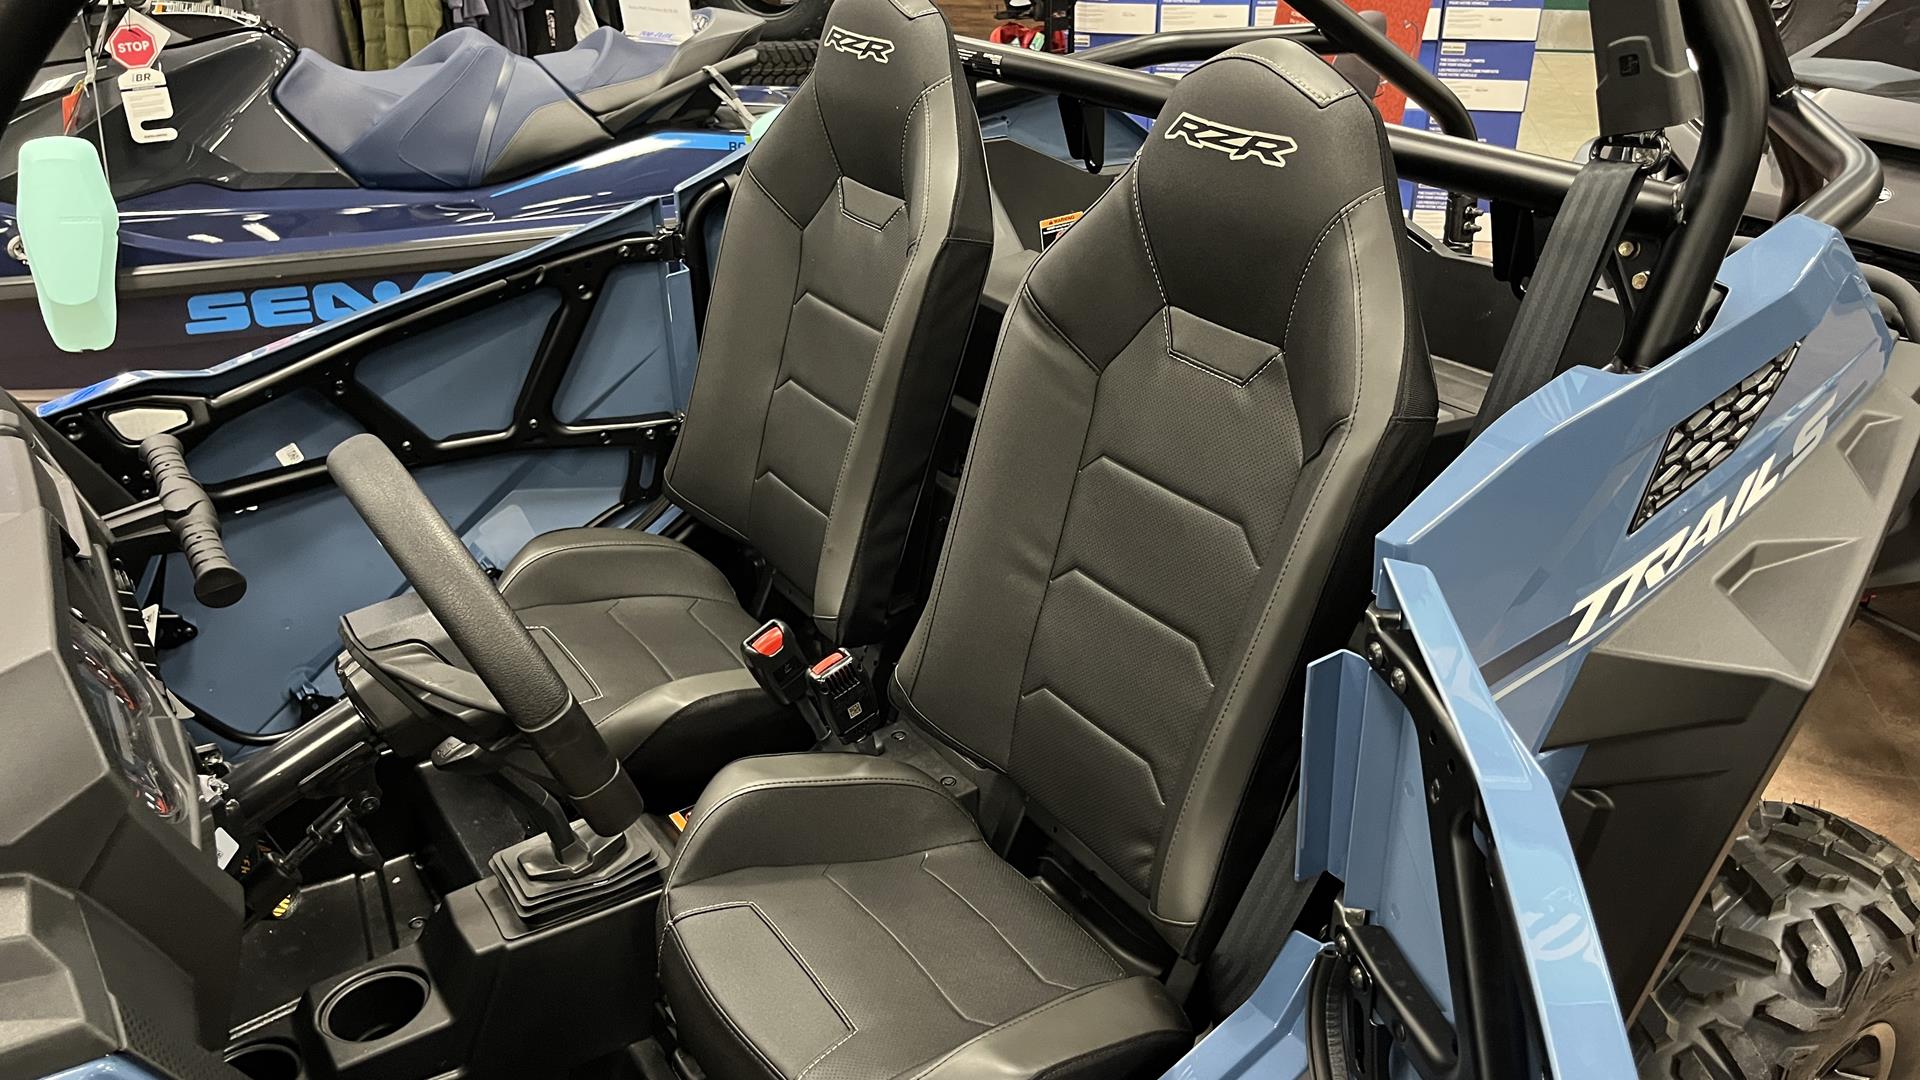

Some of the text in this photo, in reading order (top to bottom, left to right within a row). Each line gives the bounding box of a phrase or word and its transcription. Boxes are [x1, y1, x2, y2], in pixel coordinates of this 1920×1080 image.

[117, 40, 150, 54] STOP
[823, 25, 895, 64] RZR
[1164, 112, 1298, 167] RZR
[1568, 392, 1837, 645] TRAIL S
